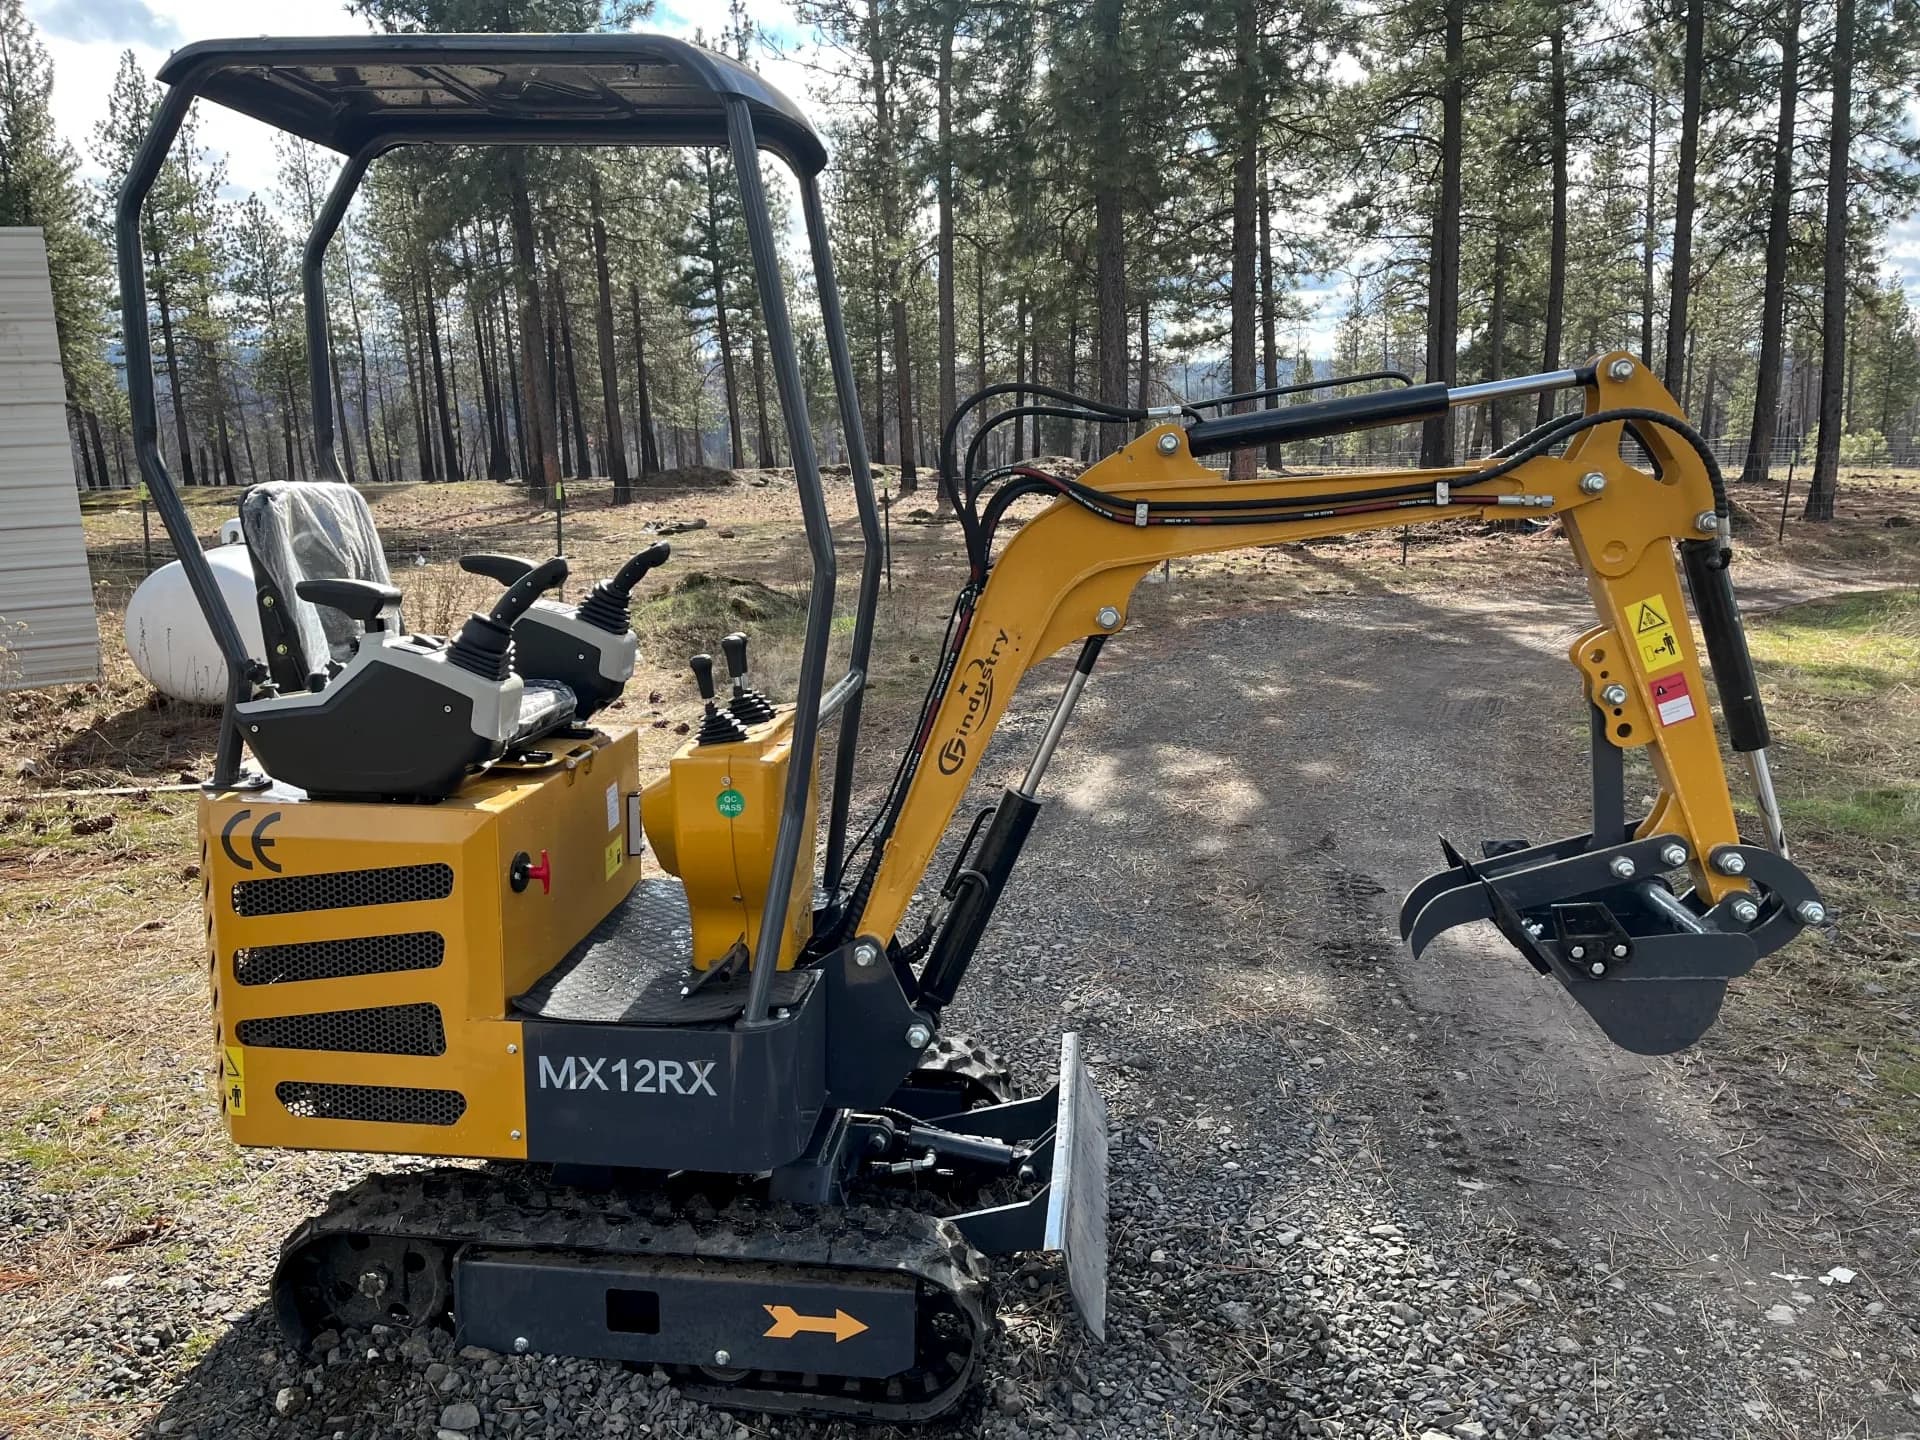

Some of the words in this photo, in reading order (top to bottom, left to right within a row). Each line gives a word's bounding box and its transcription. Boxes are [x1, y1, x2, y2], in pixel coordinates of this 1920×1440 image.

[724, 795, 737, 803] QC
[221, 809, 282, 873] CE
[538, 1055, 718, 1097] MX12RX
